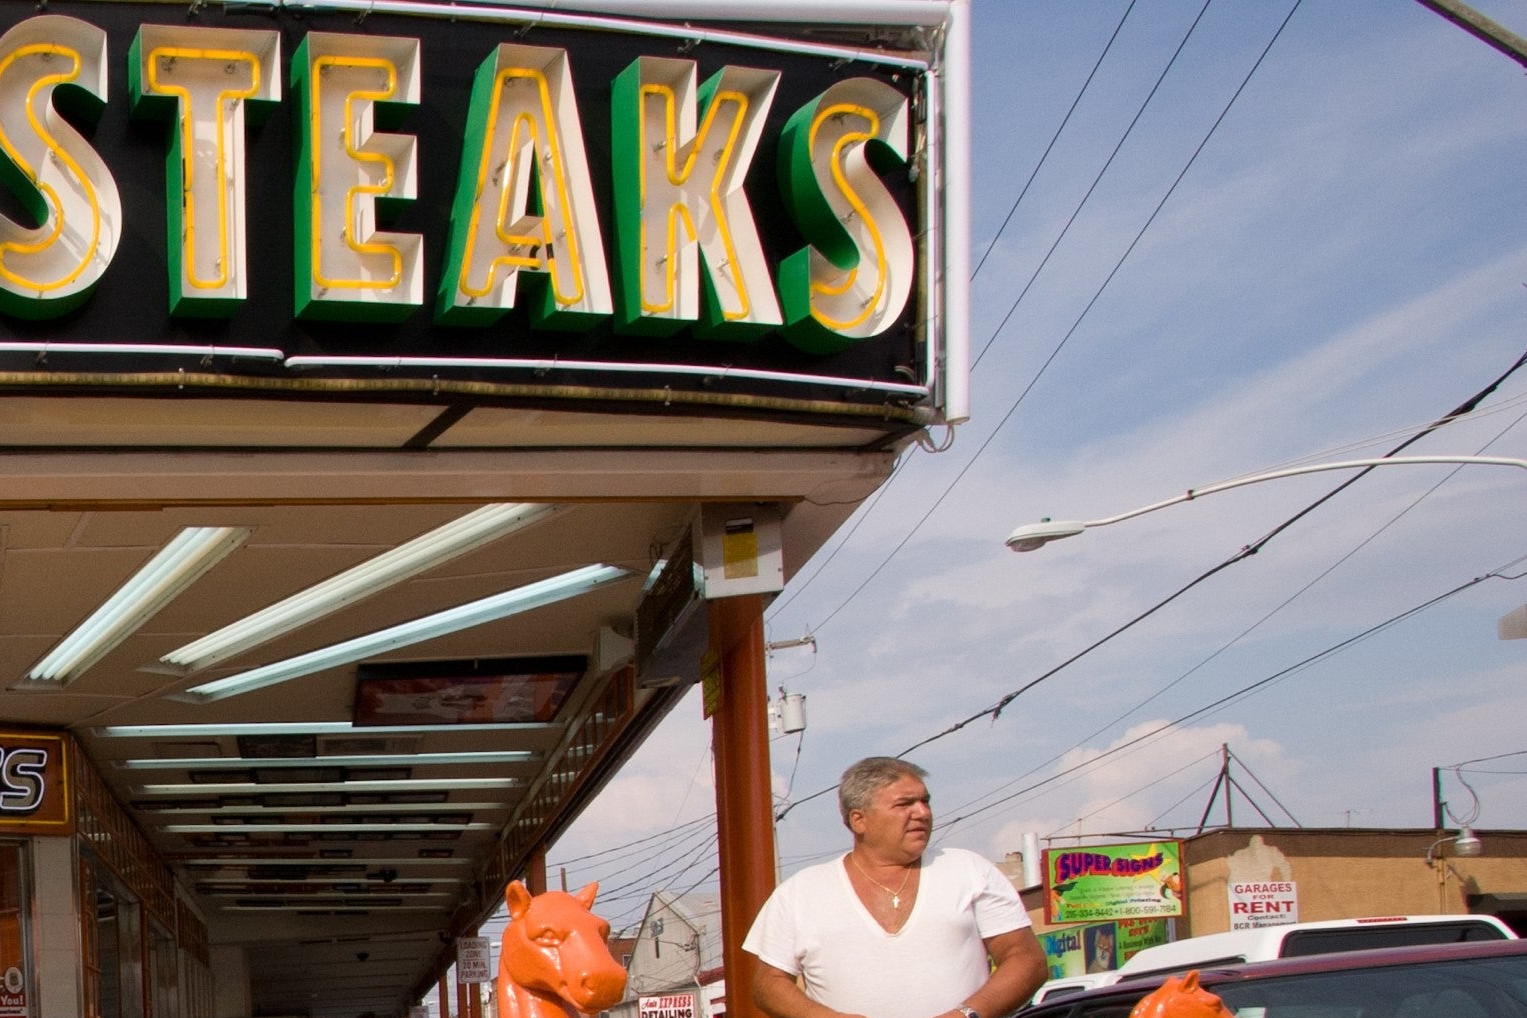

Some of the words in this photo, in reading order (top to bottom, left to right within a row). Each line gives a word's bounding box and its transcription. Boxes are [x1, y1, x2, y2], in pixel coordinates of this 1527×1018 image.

[1056, 852, 1111, 884] SUPER
[1112, 853, 1163, 876] SIGNS
[1235, 883, 1292, 894] GARAGES
[1233, 901, 1294, 914] RENT
[460, 940, 487, 949] LOADING
[465, 949, 482, 958] ZONE
[461, 970, 487, 979] PARKING
[1, 995, 24, 1006] You!
[659, 996, 691, 1009] EXPRESS
